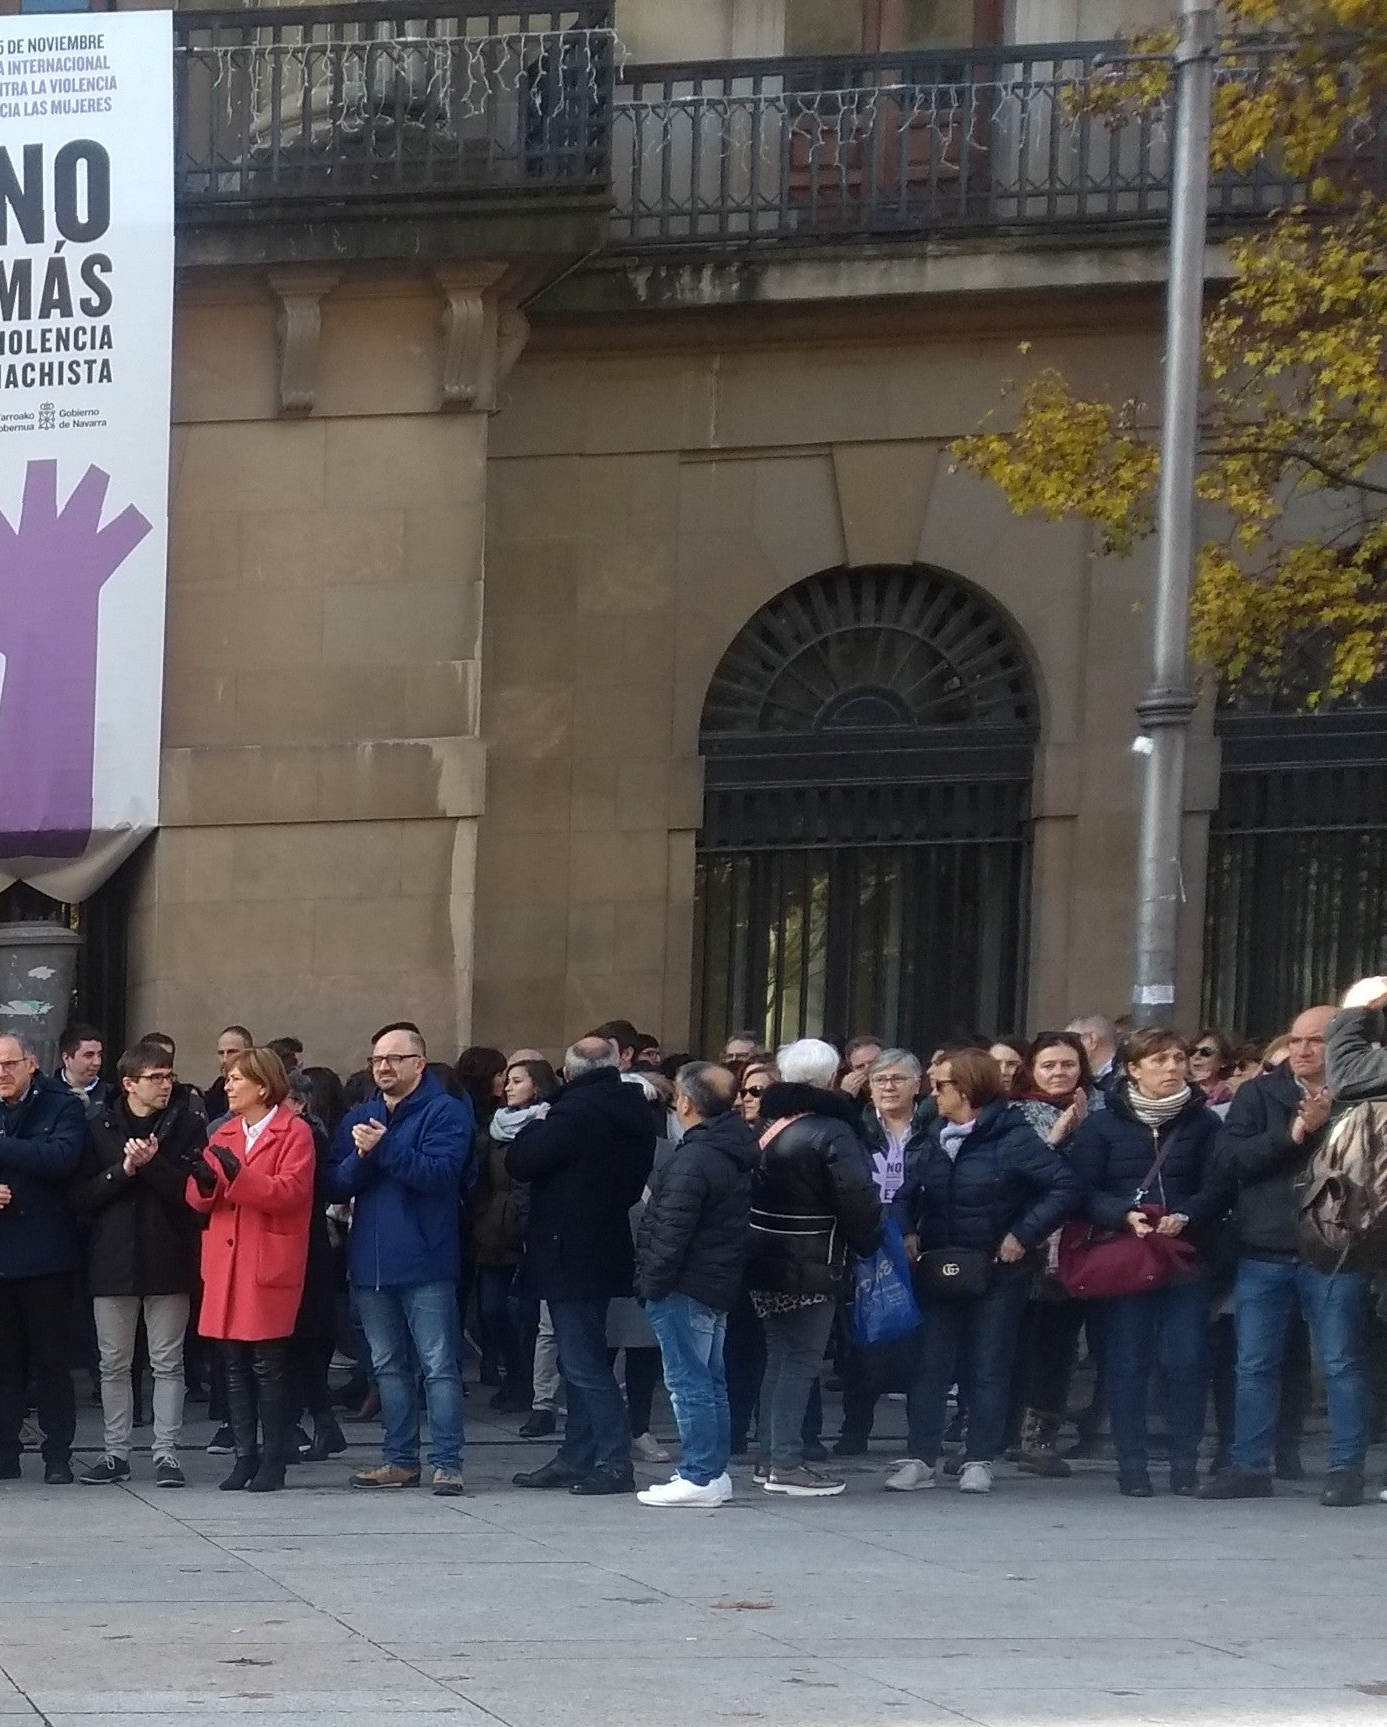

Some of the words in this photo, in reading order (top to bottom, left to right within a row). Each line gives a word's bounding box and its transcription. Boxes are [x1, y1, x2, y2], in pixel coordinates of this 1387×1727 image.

[7, 38, 25, 55] DE
[27, 34, 105, 54] NOVIEMBRE
[7, 55, 111, 76] INTERNACIONAL
[31, 79, 47, 96] LA
[49, 75, 118, 95] VIOLENCIA
[23, 100, 48, 117] LAS
[50, 97, 112, 116] MUJERES
[59, 408, 100, 419] Gobierno
[59, 419, 70, 430] de
[72, 418, 107, 429] Navarra
[886, 1162, 902, 1173] NO
